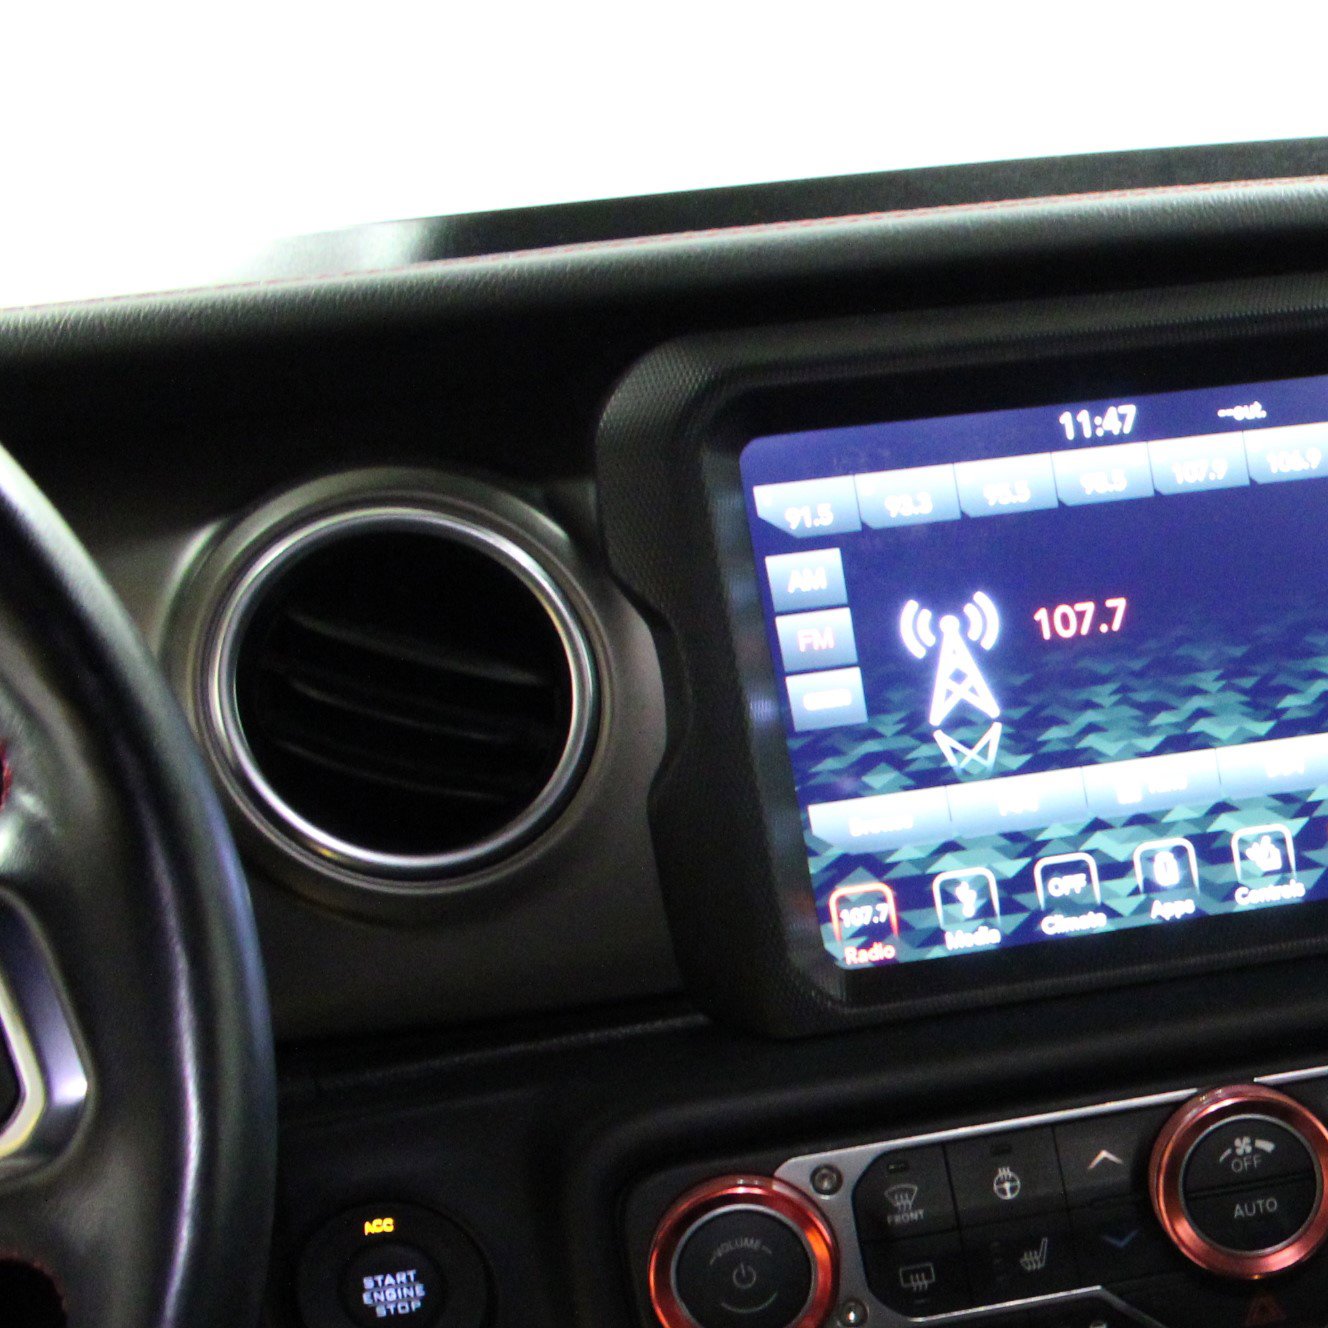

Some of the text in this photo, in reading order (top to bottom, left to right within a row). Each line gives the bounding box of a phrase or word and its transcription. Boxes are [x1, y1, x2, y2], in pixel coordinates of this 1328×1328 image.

[1060, 404, 1137, 440] 11:47
[785, 502, 834, 530] 91.5
[787, 566, 828, 594] AM
[1033, 597, 1127, 641] 107.7
[797, 625, 836, 653] FM
[1049, 872, 1088, 897] OFF
[839, 902, 890, 929] 107.7
[844, 942, 896, 966] Radio
[1150, 899, 1196, 922] Apps
[1234, 879, 1307, 906] Controls
[1231, 1153, 1263, 1173] OFF
[886, 1209, 925, 1226] FRONT
[1234, 1197, 1278, 1219] AUTO
[362, 1269, 417, 1290] START
[362, 1283, 426, 1305] ENGINE
[375, 1302, 422, 1319] STOP
